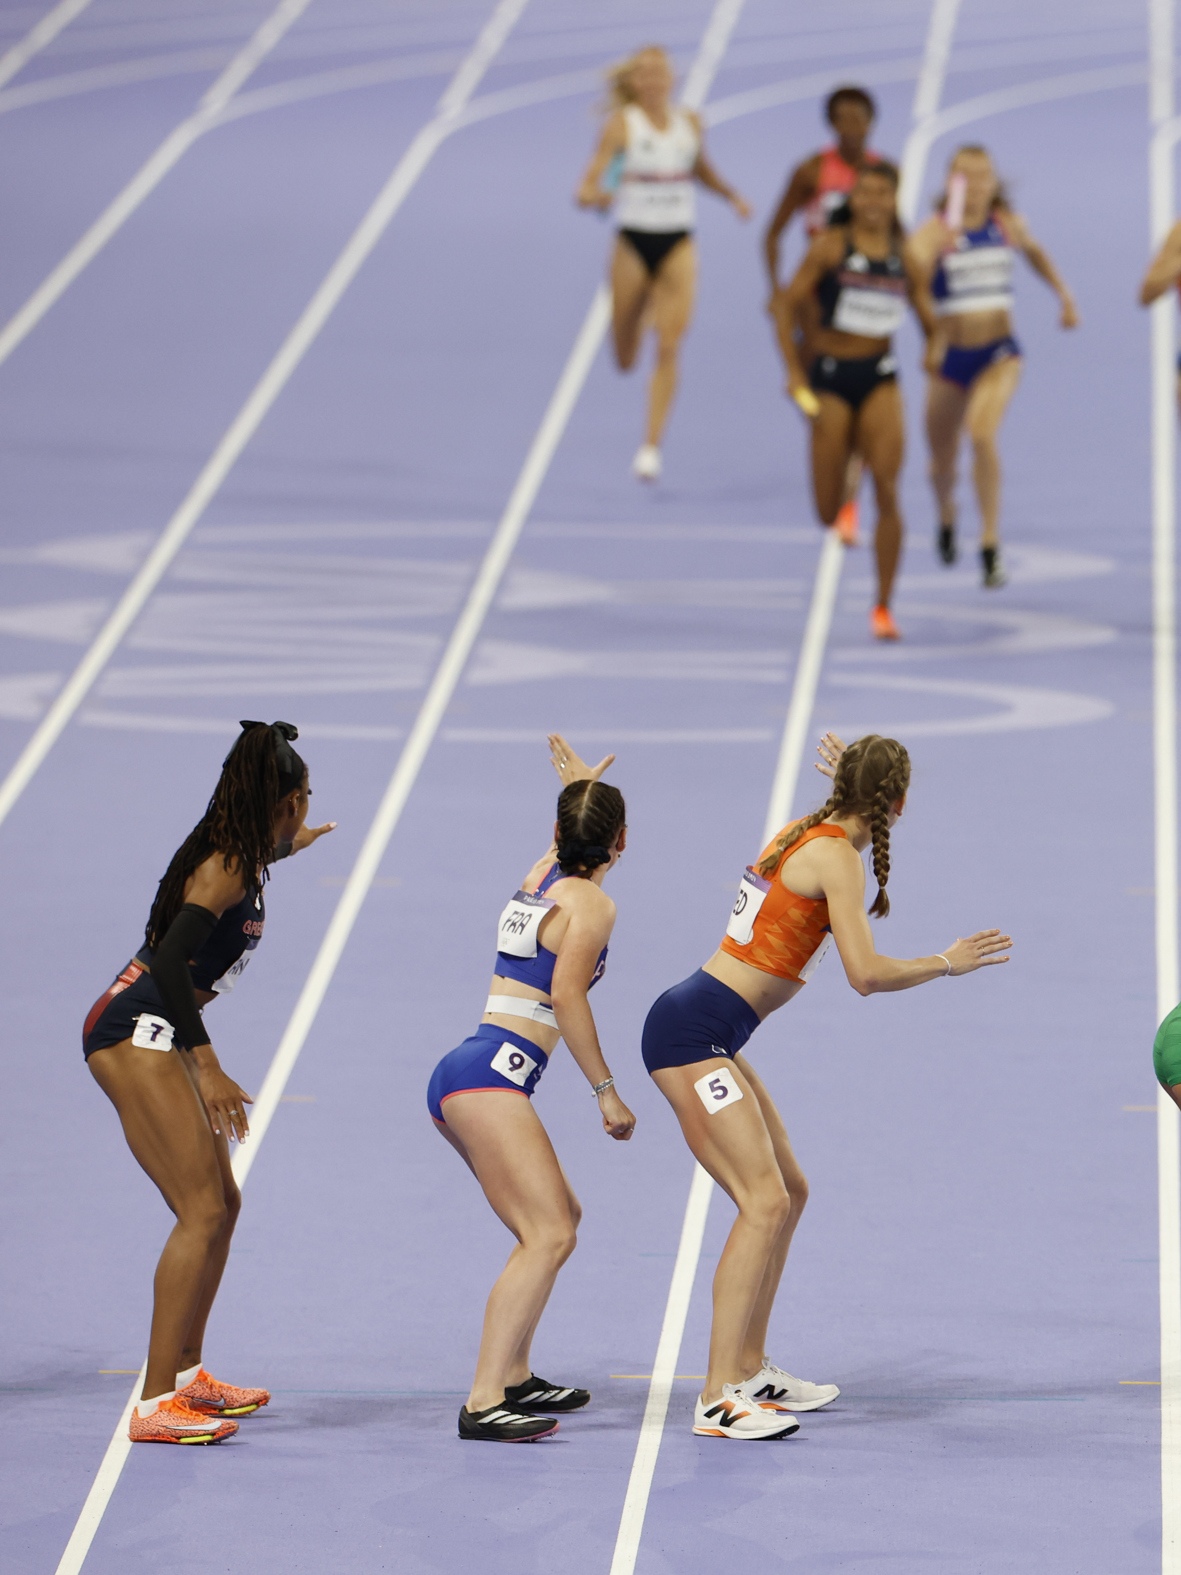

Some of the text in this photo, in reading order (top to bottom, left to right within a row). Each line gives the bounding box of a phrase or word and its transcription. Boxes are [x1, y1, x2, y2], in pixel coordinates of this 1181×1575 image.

[501, 910, 533, 936] FRA
[150, 1022, 165, 1042] 7
[508, 1052, 526, 1072] 9
[708, 1077, 729, 1101] 5
